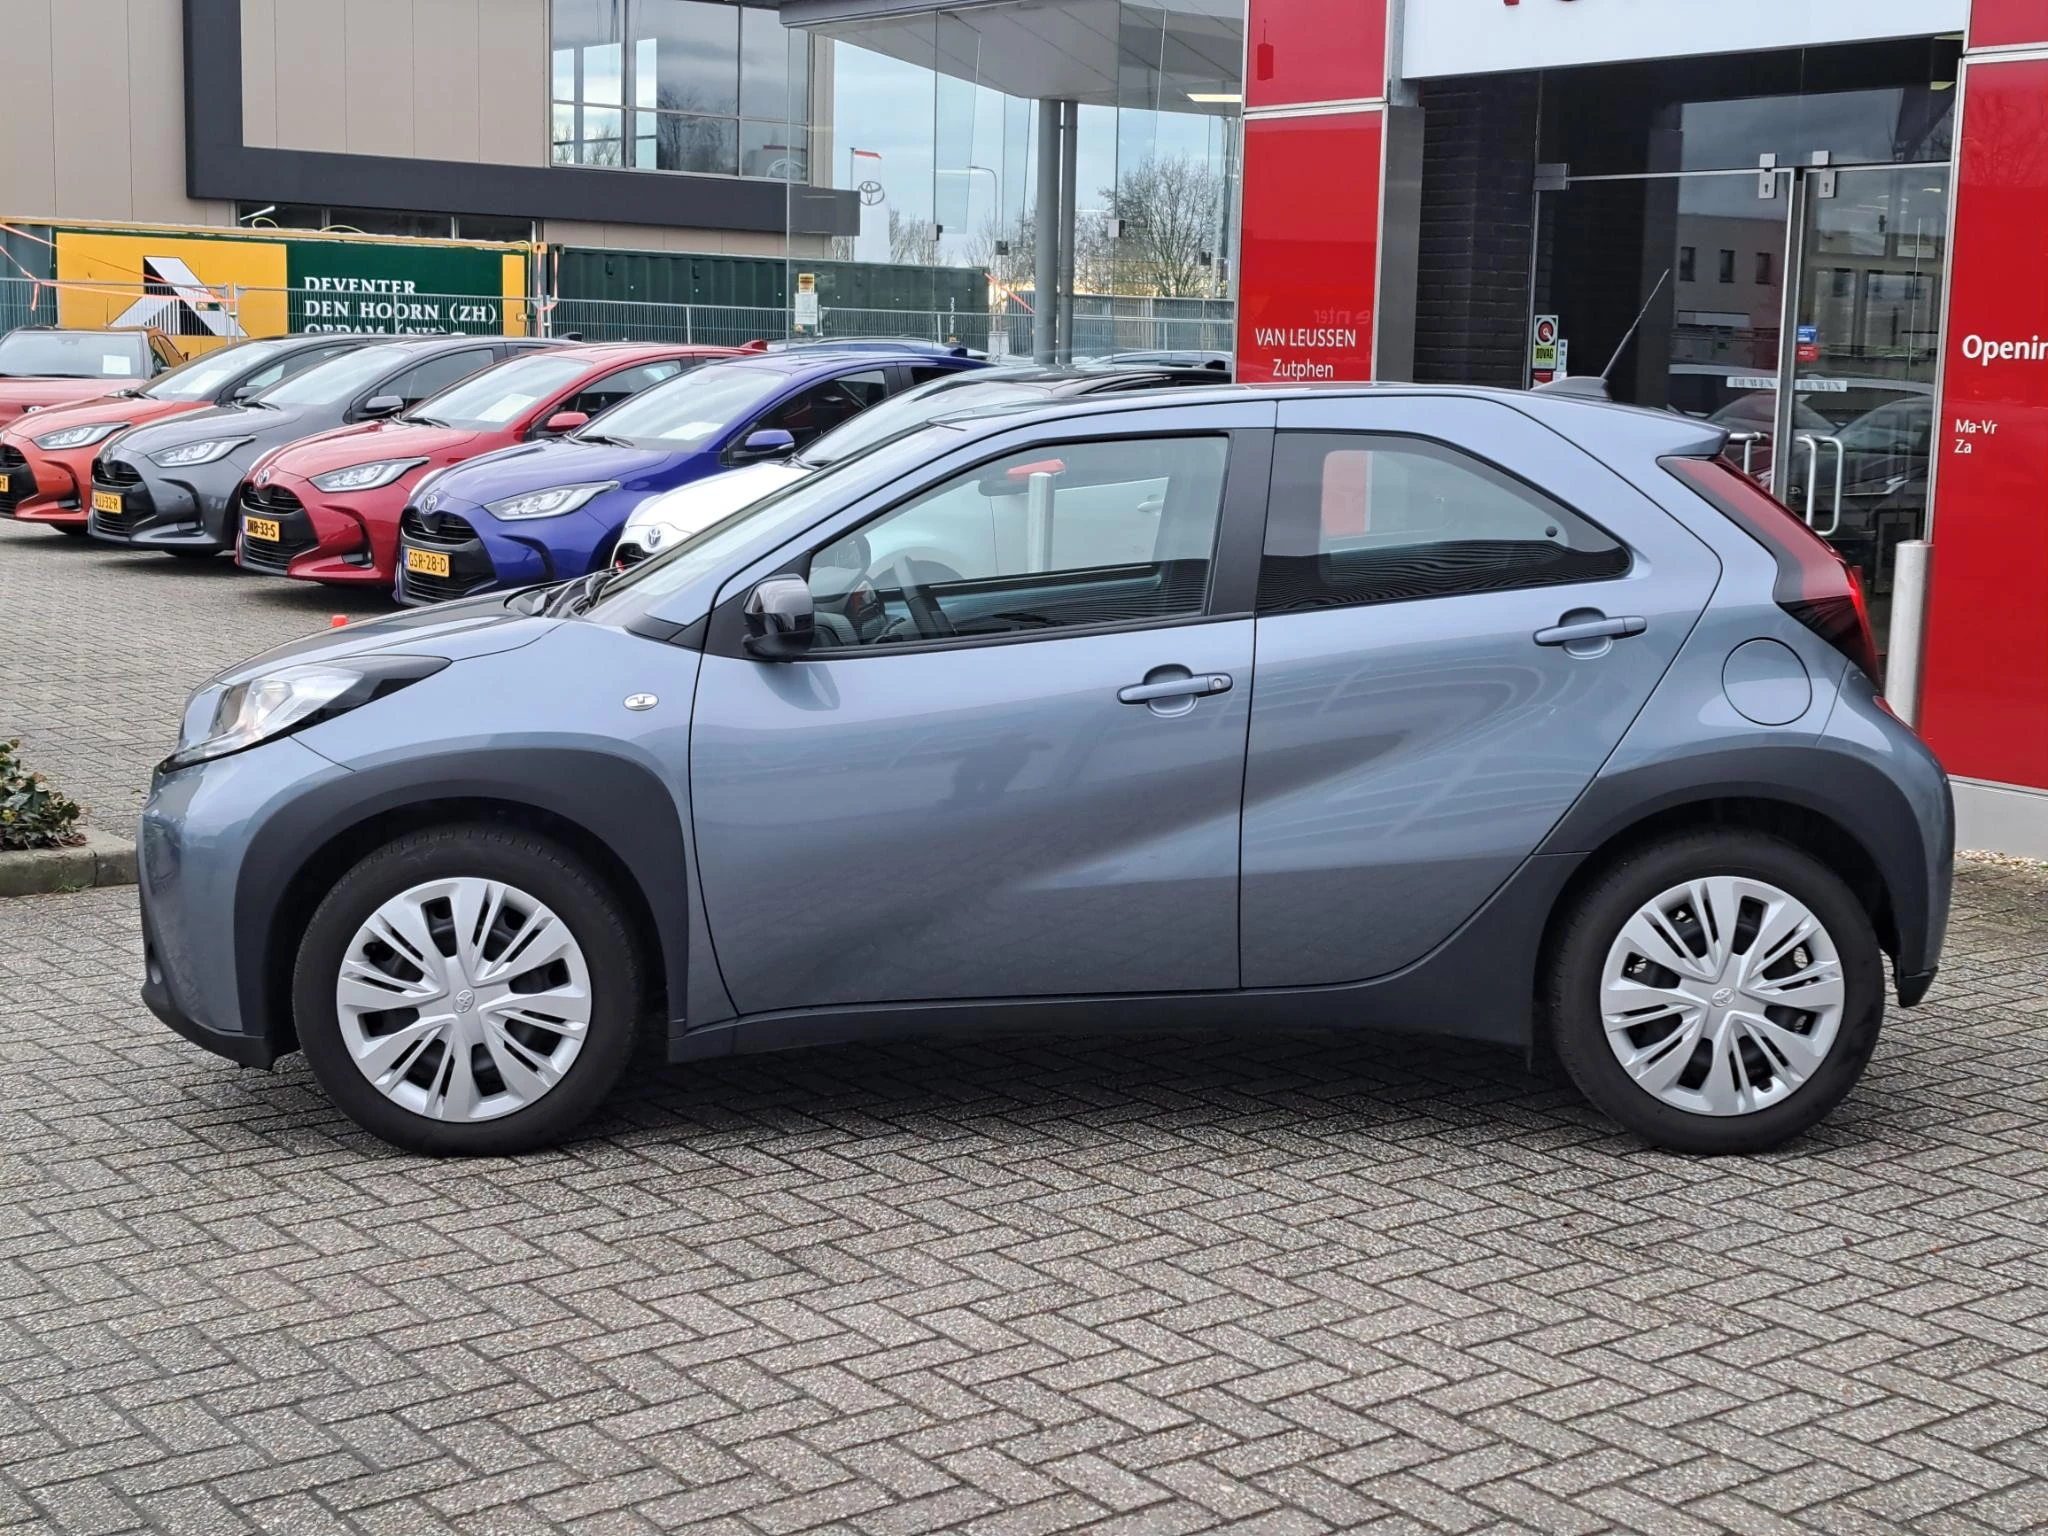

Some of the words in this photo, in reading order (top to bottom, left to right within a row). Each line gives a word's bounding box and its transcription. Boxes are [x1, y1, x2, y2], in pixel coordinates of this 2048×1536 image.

[304, 276, 416, 295] DEVENTER
[304, 300, 349, 317] DEN
[360, 302, 439, 320] HOORN
[449, 302, 496, 325] (ZH)
[1255, 327, 1285, 346] VAN
[1289, 328, 1356, 347] LEUSSEN
[1272, 358, 1334, 381] Zutphen
[1955, 418, 1998, 435] Ma-Vr
[1954, 438, 1972, 454] Za
[408, 551, 447, 573] GSR-28-D
